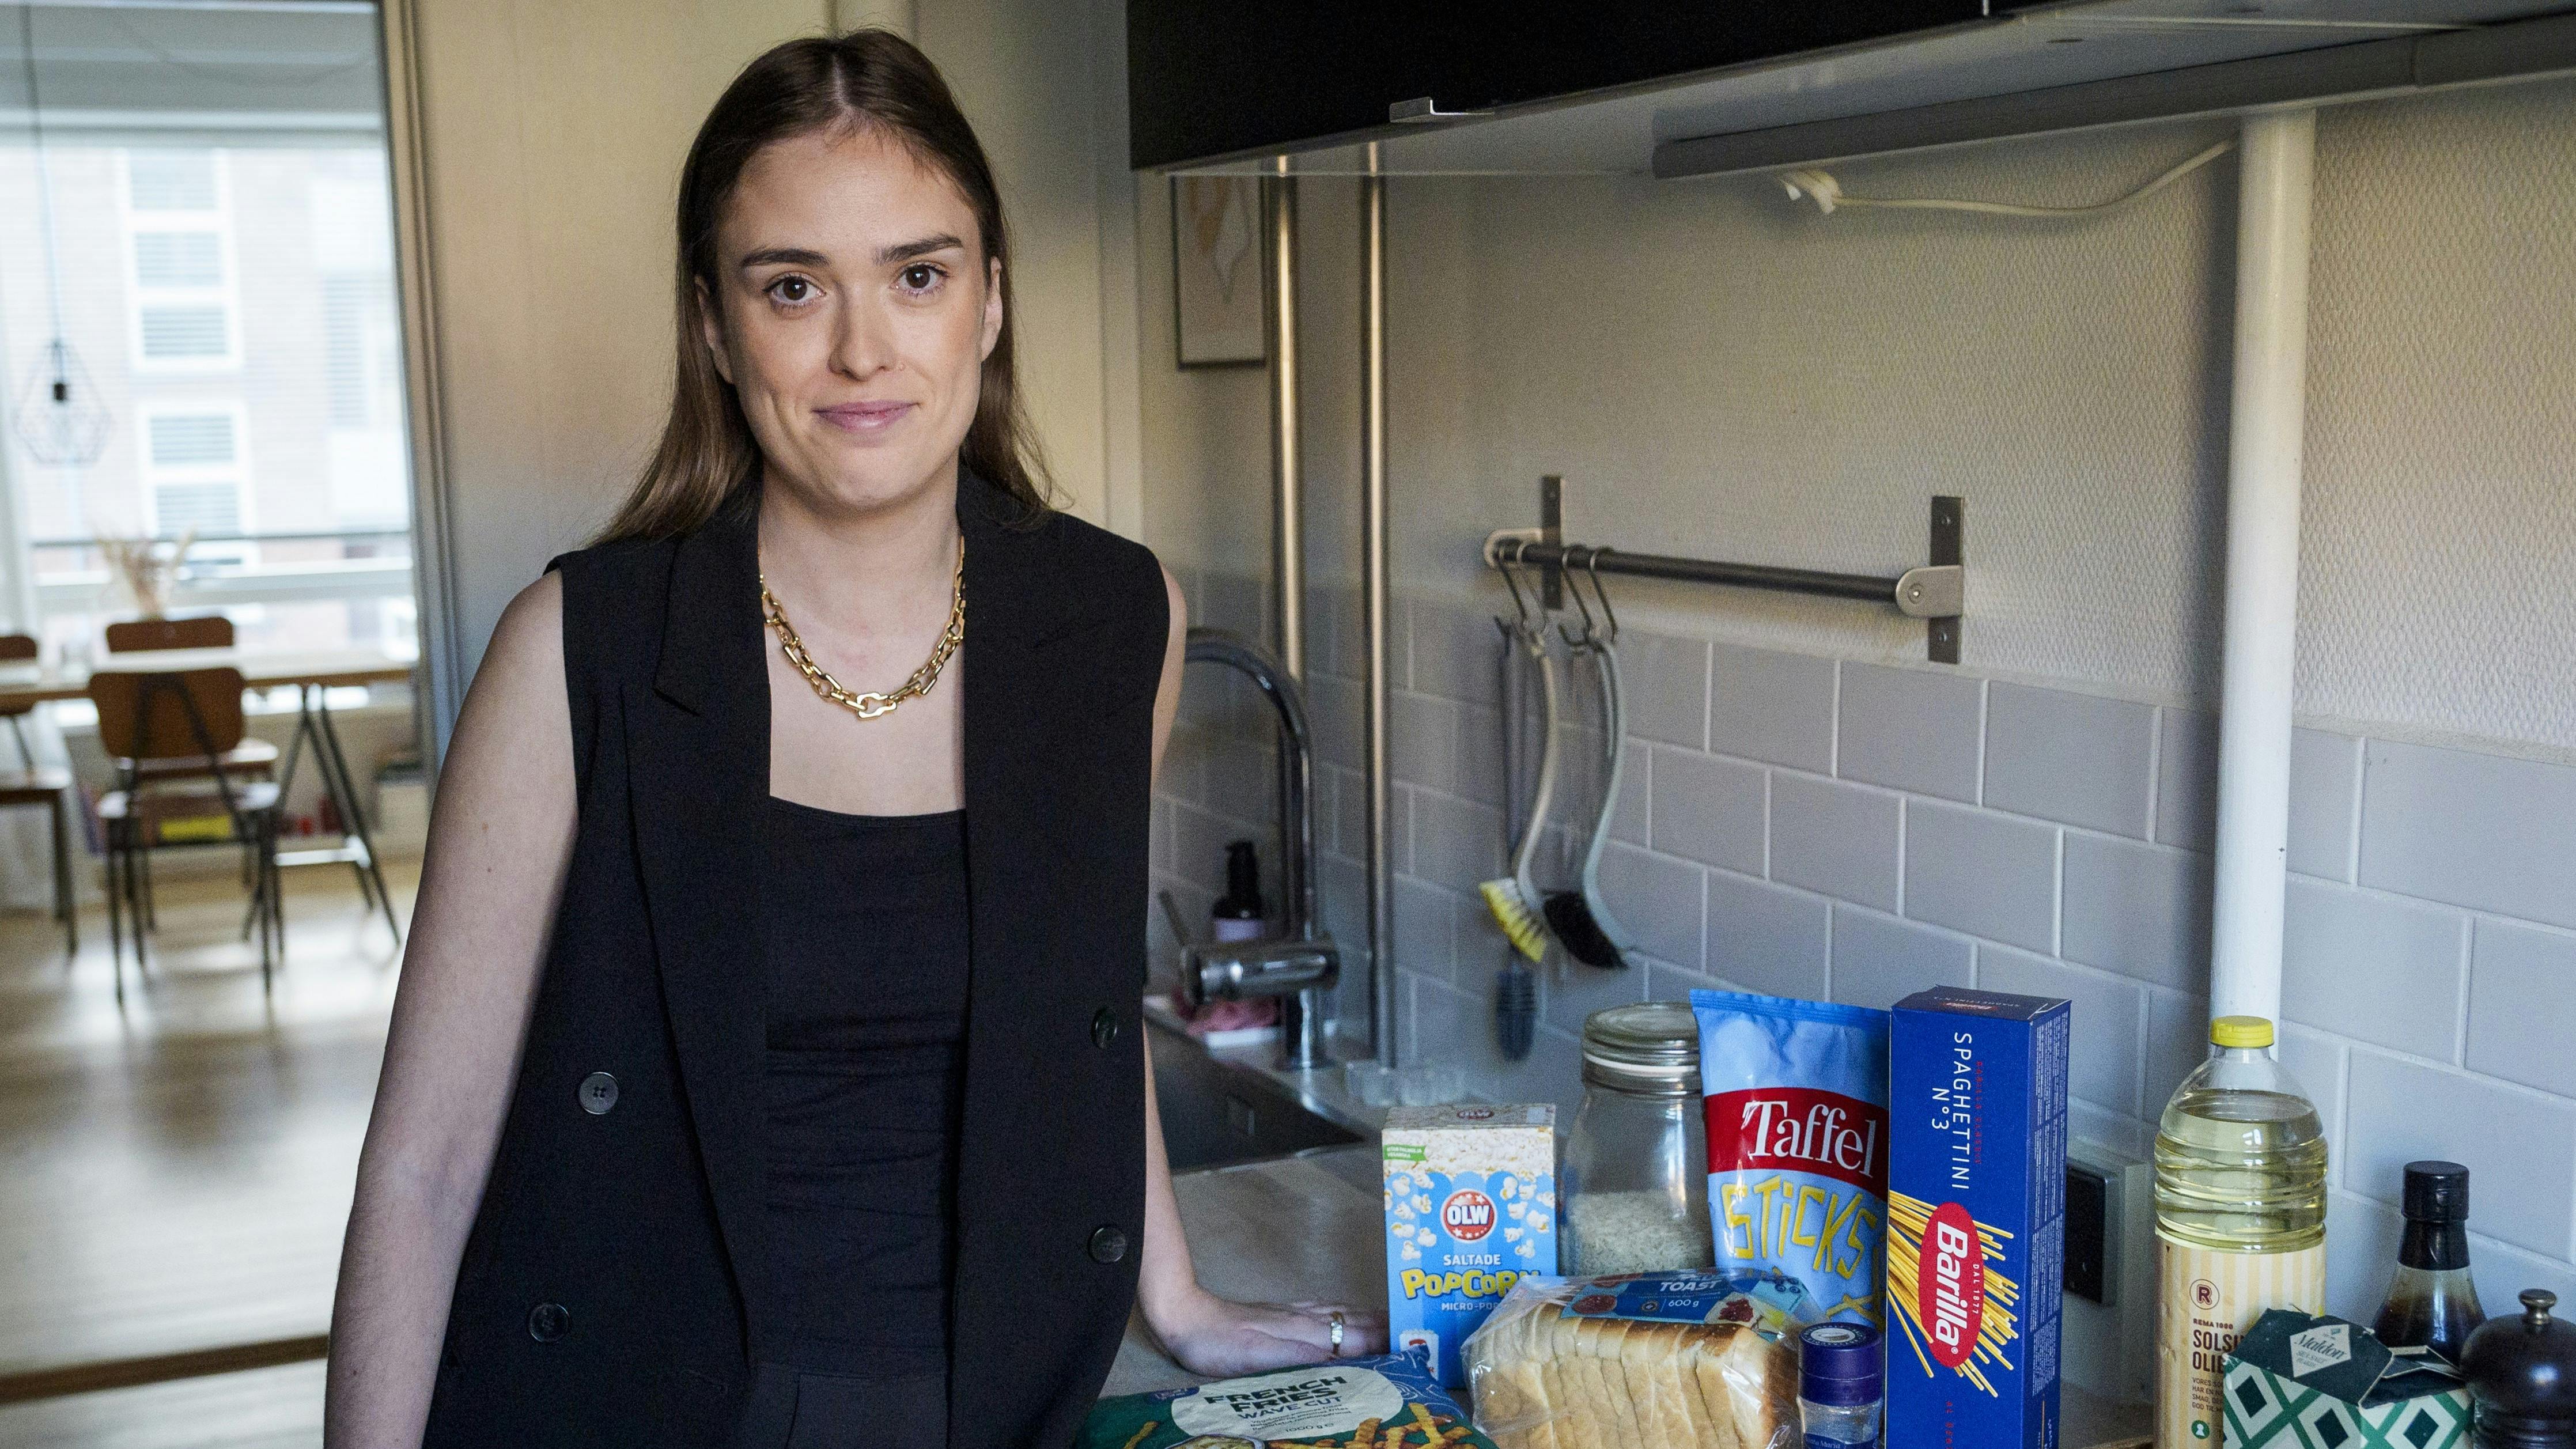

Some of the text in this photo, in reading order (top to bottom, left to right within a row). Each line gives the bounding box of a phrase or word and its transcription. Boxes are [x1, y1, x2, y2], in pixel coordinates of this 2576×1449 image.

[1951, 1032, 1973, 1189] SPAGHETTINI
[1741, 1100, 1877, 1178] Taffel
[1446, 1205, 1490, 1225] OLW
[1443, 1254, 1501, 1266] SALTADE
[1660, 1279, 1722, 1292] TOAST
[1935, 1221, 1968, 1346] Barilla
[1972, 1263, 1980, 1314] DAL 1877
[1668, 1299, 1691, 1307] 600
[2193, 1318, 2214, 1327] REMA
[2294, 1334, 2347, 1360] Maldon
[1204, 1376, 1348, 1404] FRENCH
[2192, 1377, 2211, 1387] VORES
[2192, 1385, 2204, 1393] HAR
[1230, 1387, 1337, 1412] FRIES
[1238, 1395, 1342, 1419] WAVE CUT
[2192, 1402, 2204, 1410] GOD
